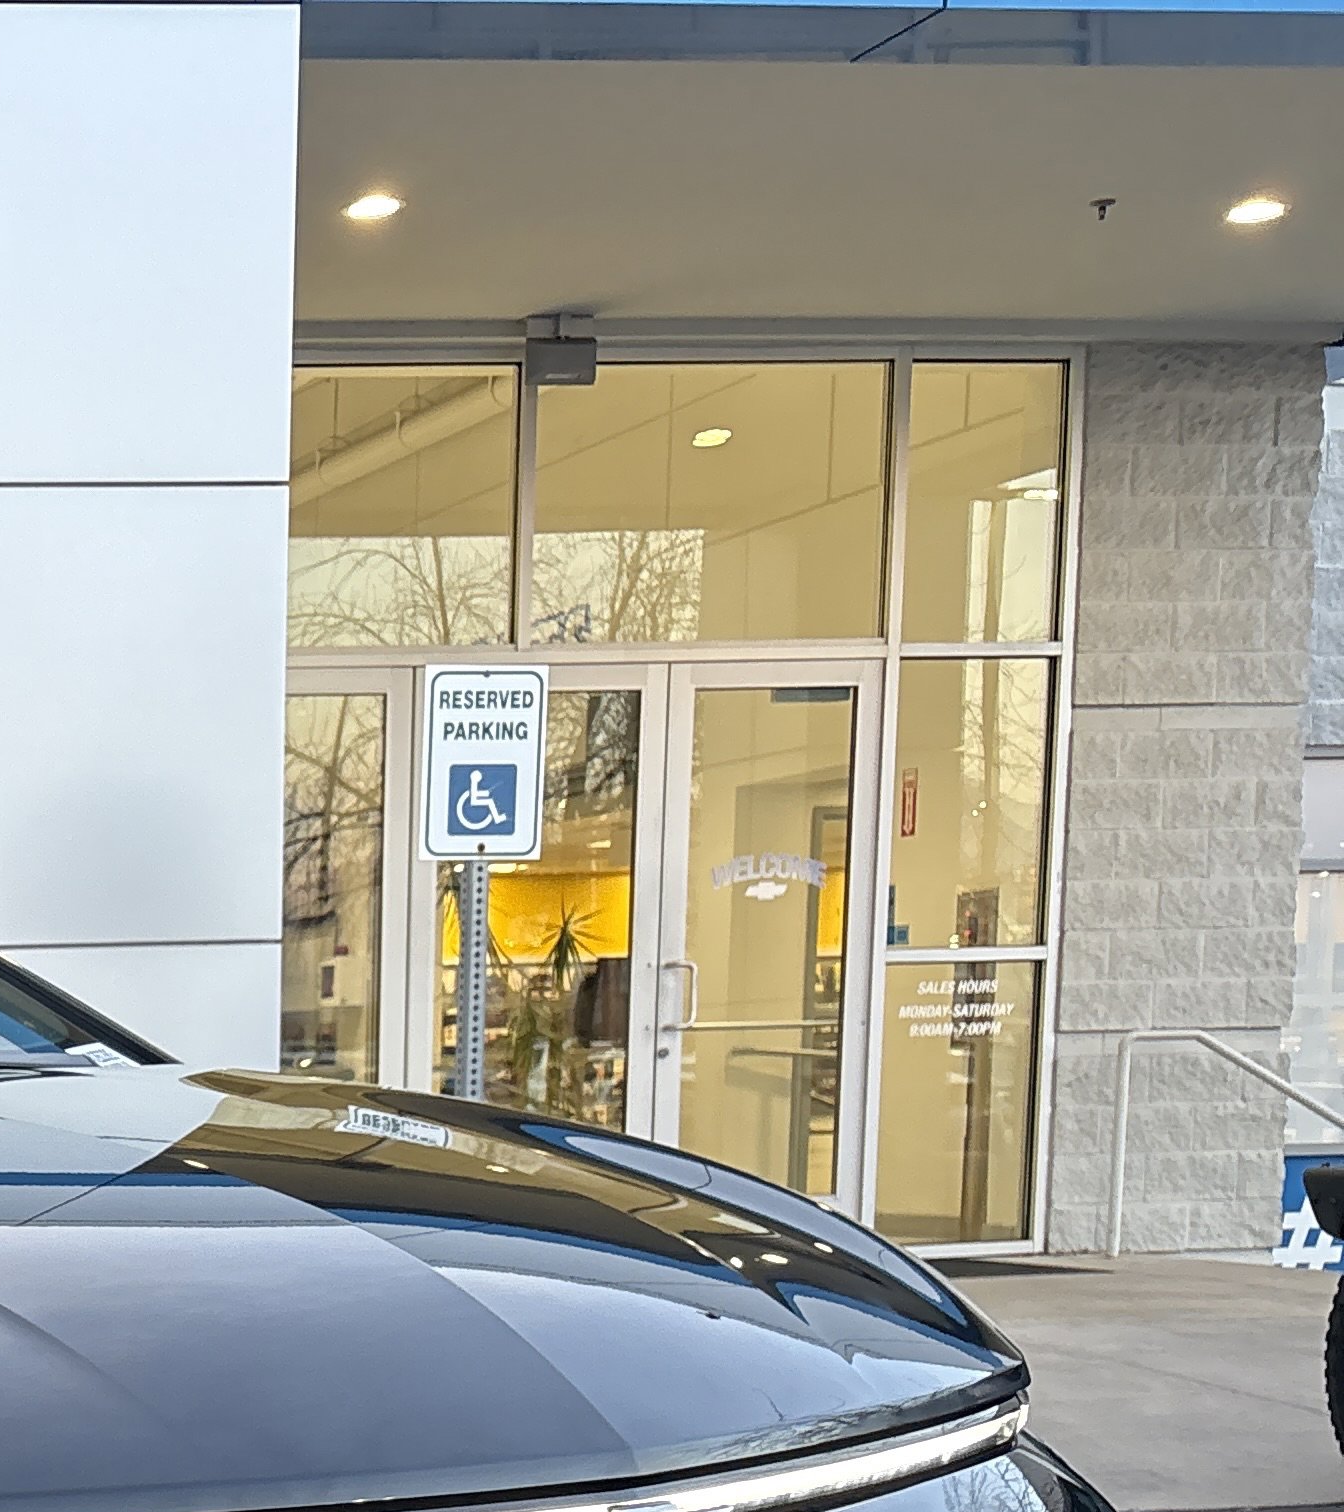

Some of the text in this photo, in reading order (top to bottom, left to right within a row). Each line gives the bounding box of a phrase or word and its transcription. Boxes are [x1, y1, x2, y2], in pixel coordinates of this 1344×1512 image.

[438, 689, 534, 710] RESERVED
[442, 721, 529, 741] PARKING
[712, 852, 828, 890] WELCOME
[917, 978, 999, 995] SALES HOURS
